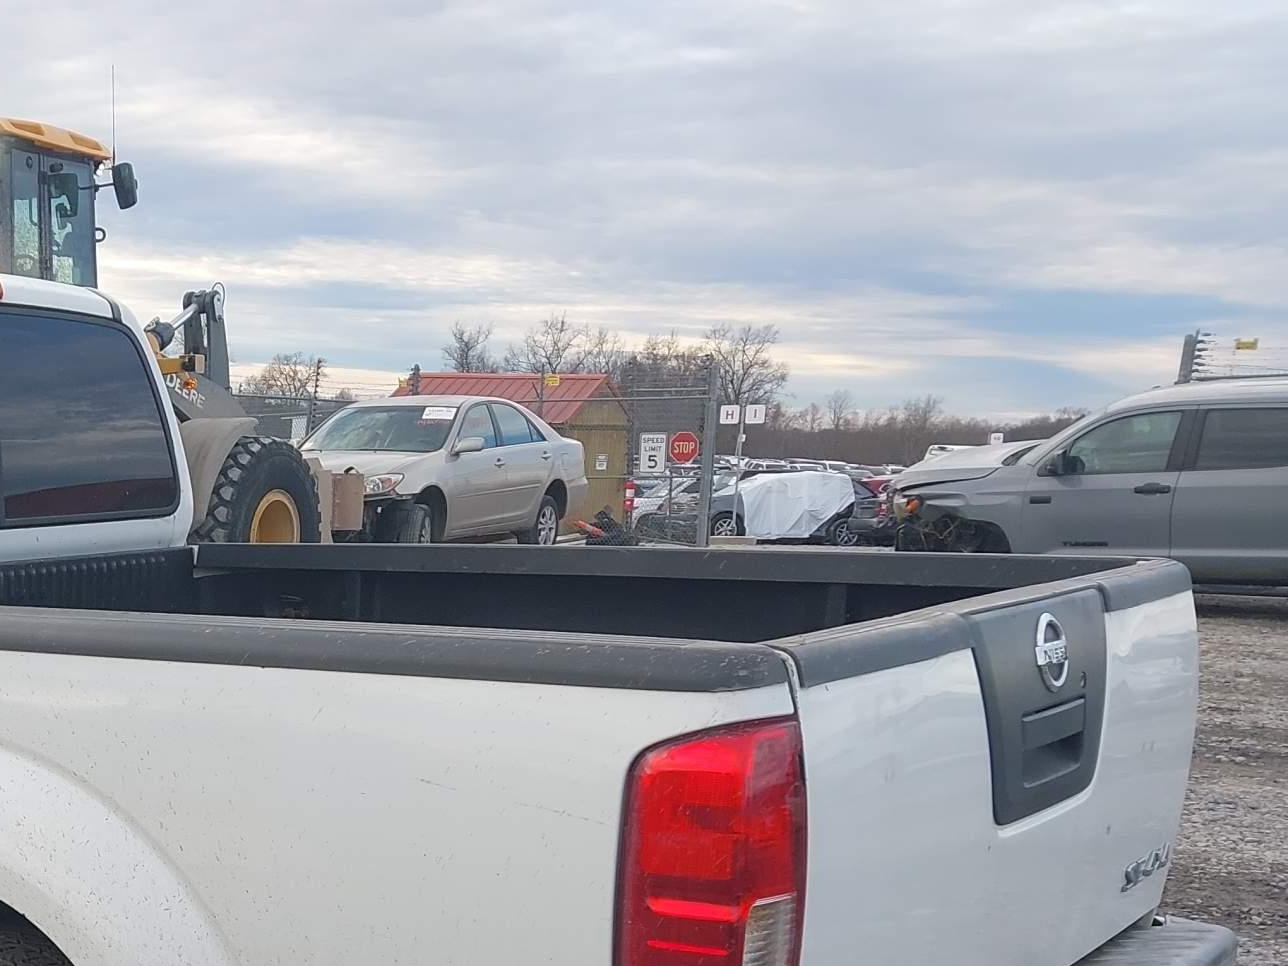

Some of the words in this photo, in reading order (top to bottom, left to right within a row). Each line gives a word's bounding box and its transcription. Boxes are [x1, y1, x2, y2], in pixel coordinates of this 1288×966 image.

[725, 409, 735, 420] H
[673, 441, 695, 454] STOP
[647, 454, 658, 469] 5
